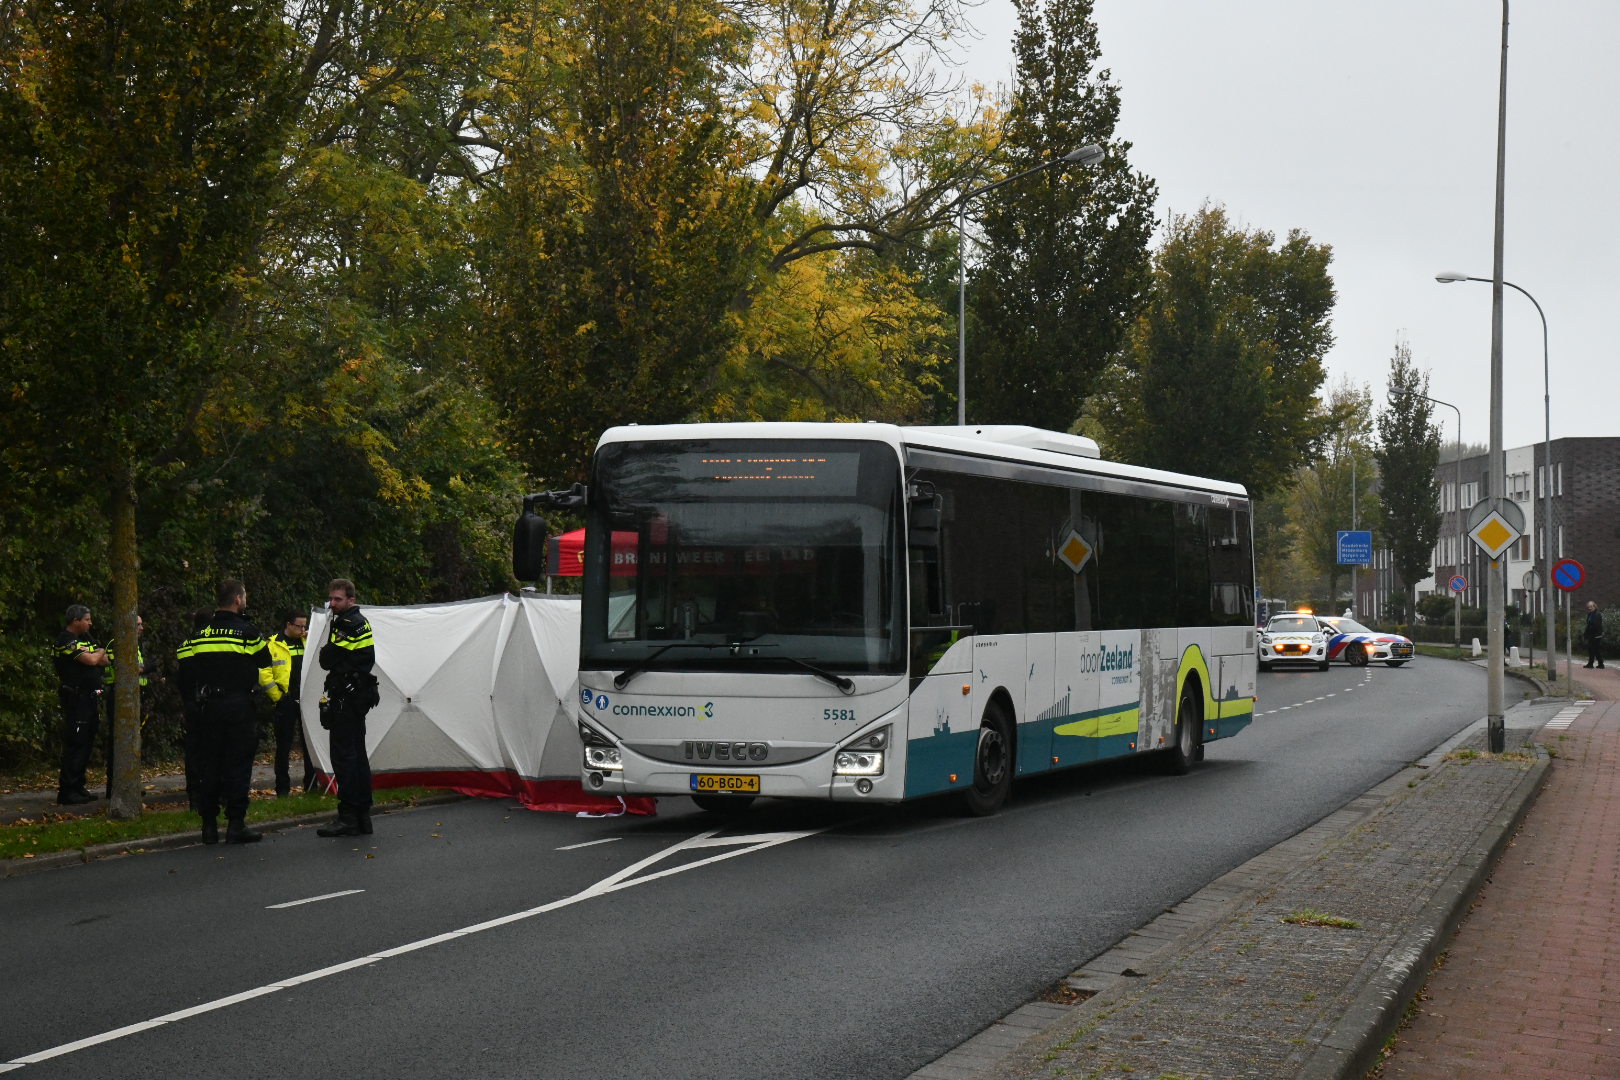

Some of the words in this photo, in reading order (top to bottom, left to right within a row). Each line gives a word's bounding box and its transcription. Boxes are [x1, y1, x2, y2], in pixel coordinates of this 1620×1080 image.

[612, 704, 695, 717] connexxion
[823, 708, 856, 721] 5581
[684, 741, 768, 761] IVECO
[699, 777, 755, 789] 60-BGD-4
